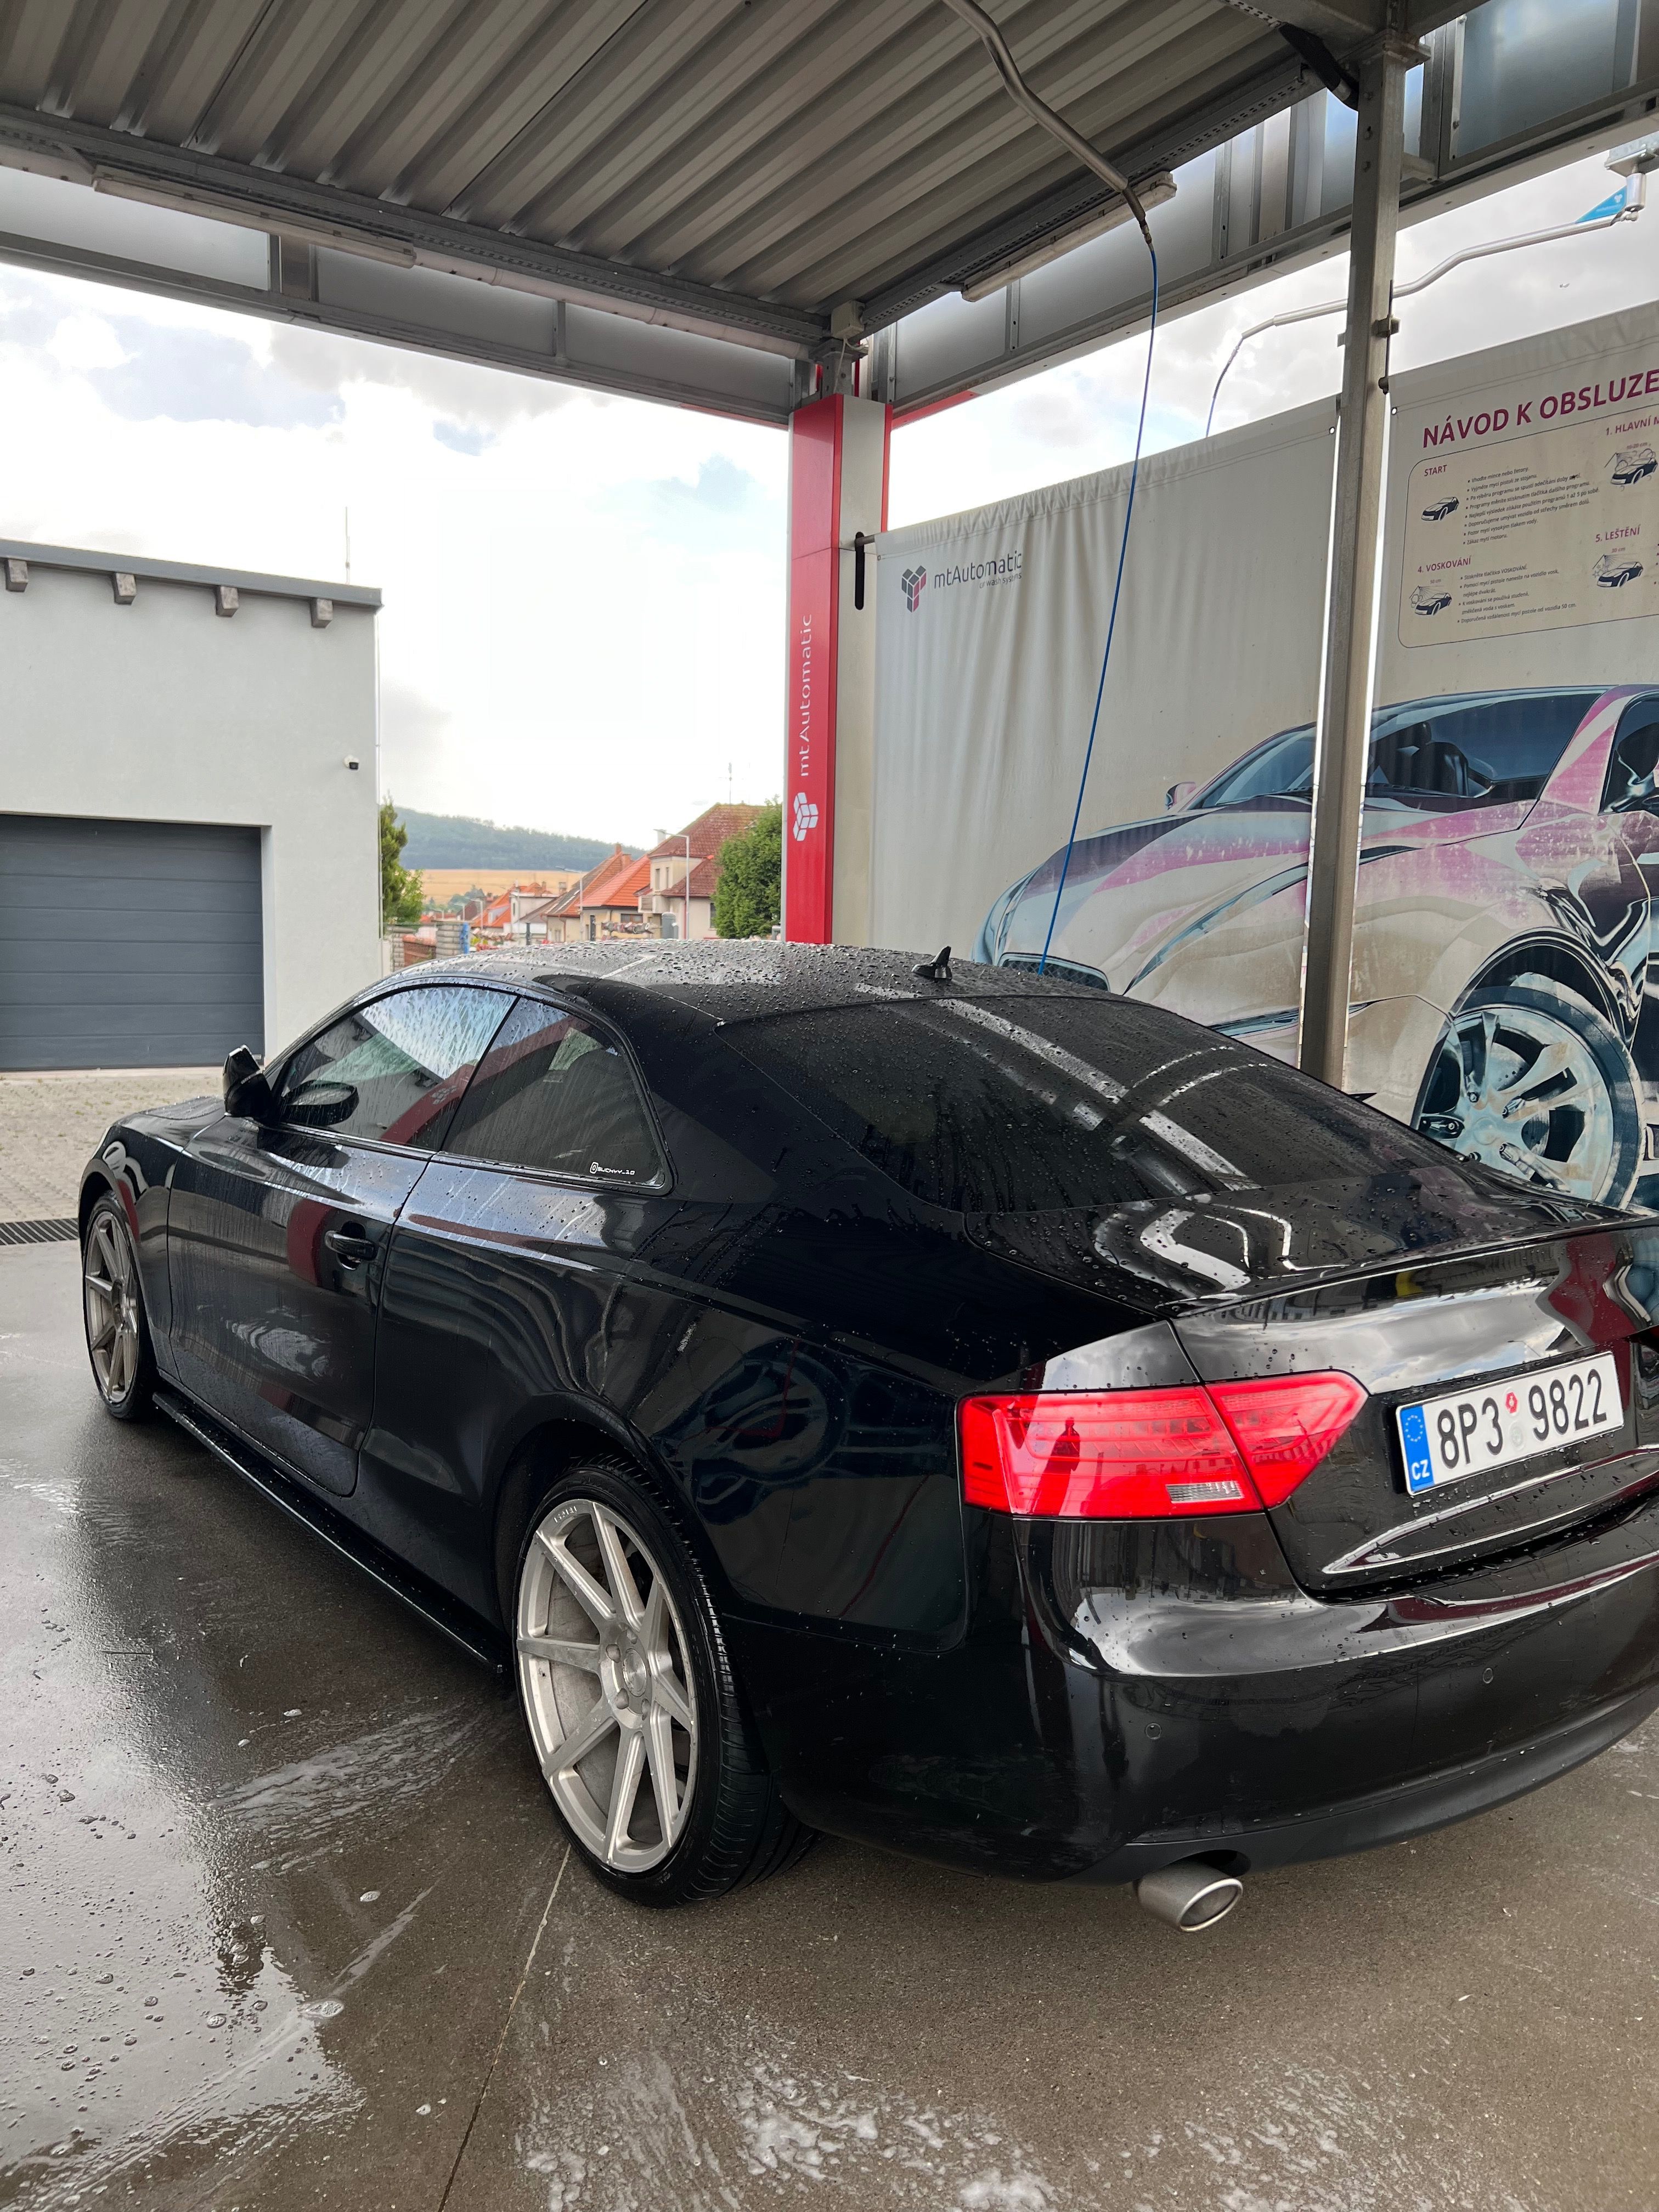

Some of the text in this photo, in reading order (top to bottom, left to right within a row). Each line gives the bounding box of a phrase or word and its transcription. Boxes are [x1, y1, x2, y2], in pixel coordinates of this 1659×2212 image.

[1423, 369, 1659, 448] NÁVOD K OBSLUZE
[1606, 427, 1612, 436] 1.
[1615, 415, 1651, 433] HLAVNÍ
[1424, 464, 1447, 477] START
[1487, 507, 1505, 516] výsledek
[1469, 518, 1499, 527] Doporučujeme
[1595, 524, 1641, 543] 5. LEŠTĚNÍ
[934, 550, 1022, 589] mtAutomatic
[1426, 555, 1471, 572] VOSKOVÁNÍ
[986, 577, 1001, 586] wash
[799, 614, 812, 776] mtAutomatic
[1437, 1368, 1607, 1469] 8P3 9822
[1411, 1459, 1430, 1480] CZ
